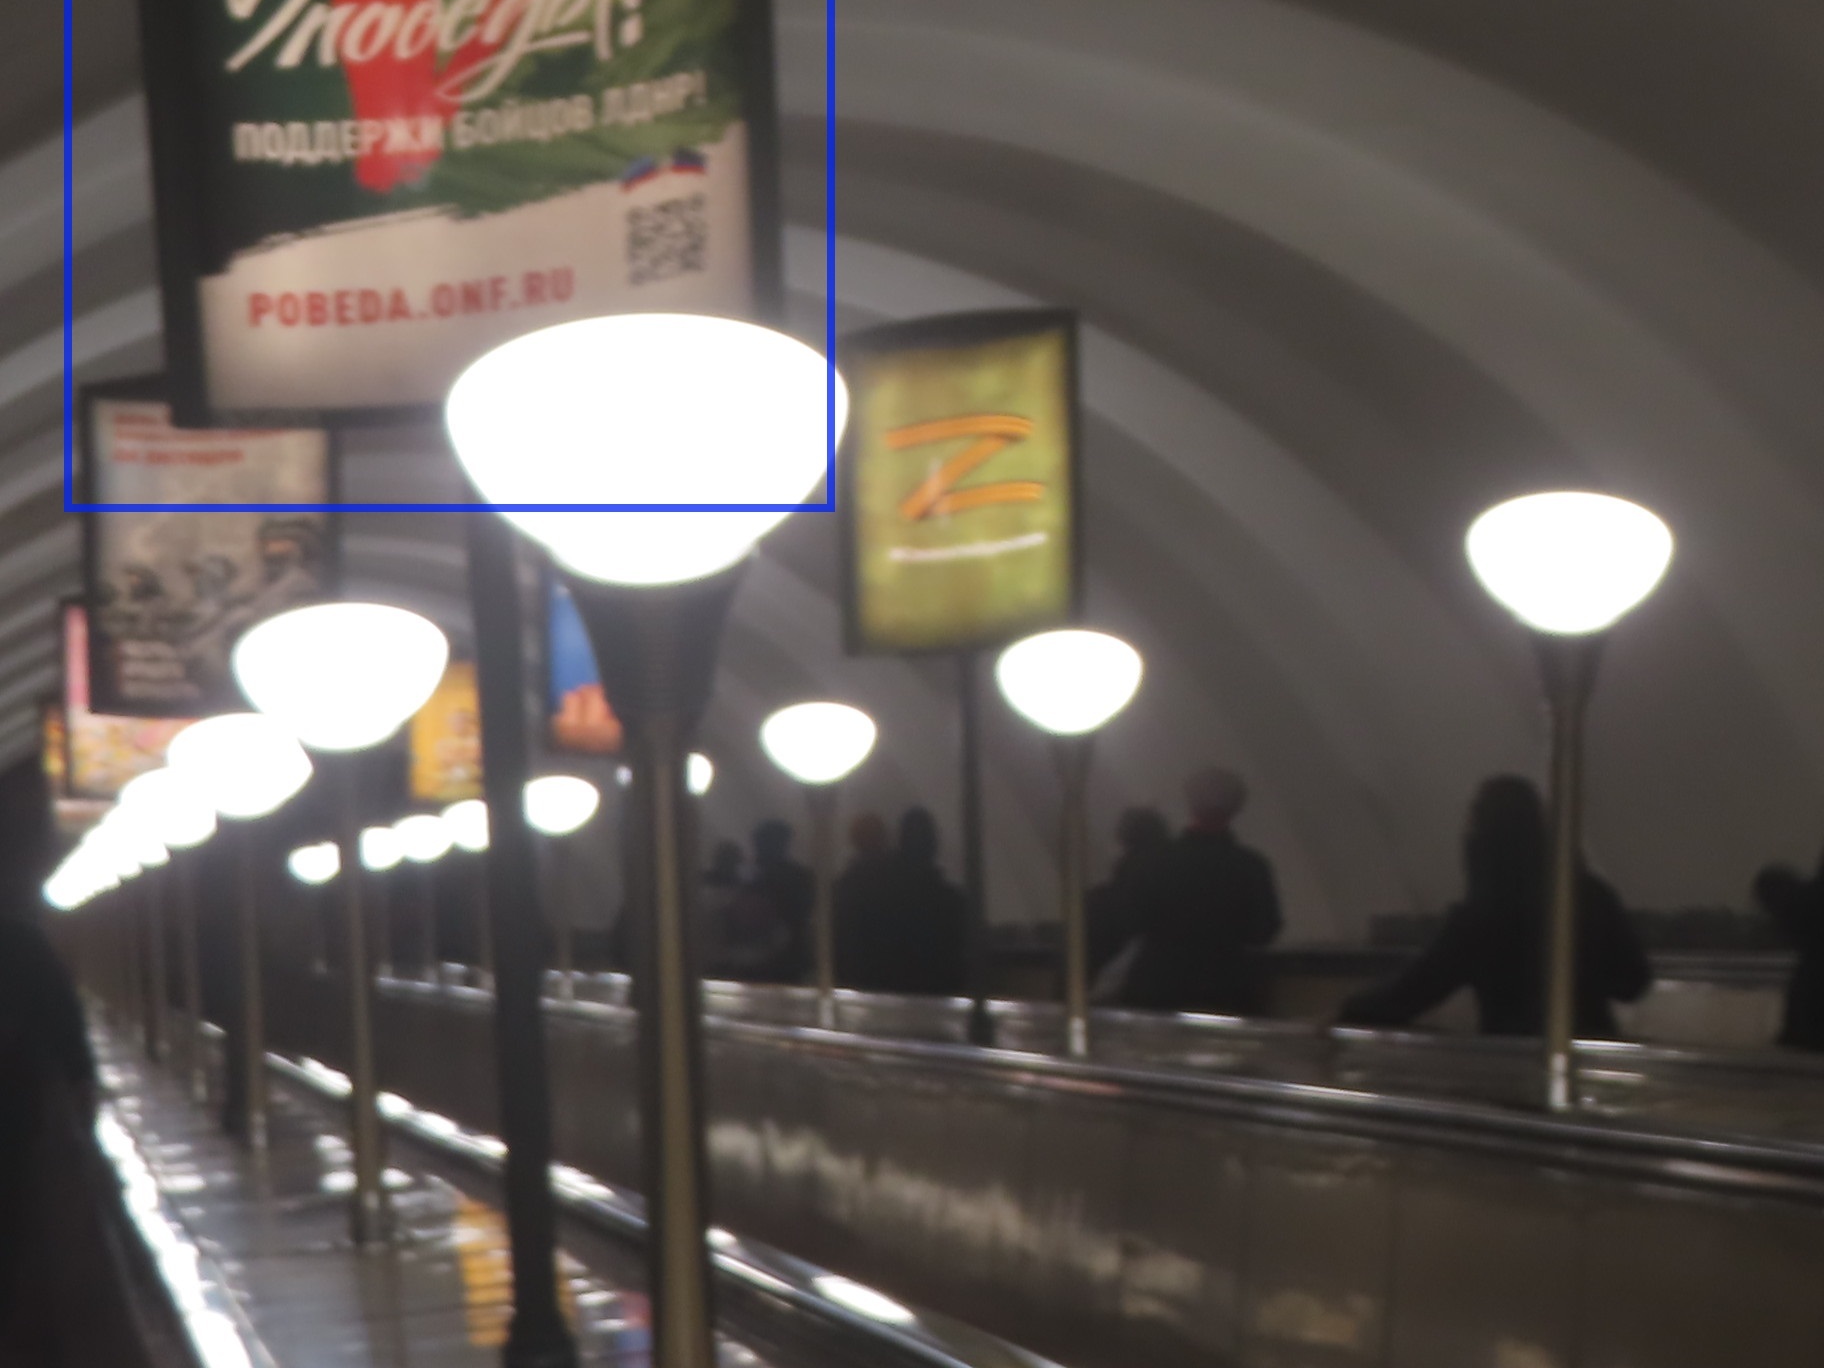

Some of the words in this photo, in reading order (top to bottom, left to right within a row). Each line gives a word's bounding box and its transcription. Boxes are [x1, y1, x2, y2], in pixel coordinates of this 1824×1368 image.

[231, 113, 444, 166] ПОДДЕРЖИ
[452, 93, 596, 149] БОЙЦОВ
[246, 265, 577, 329] POBEDA.ONF.RU
